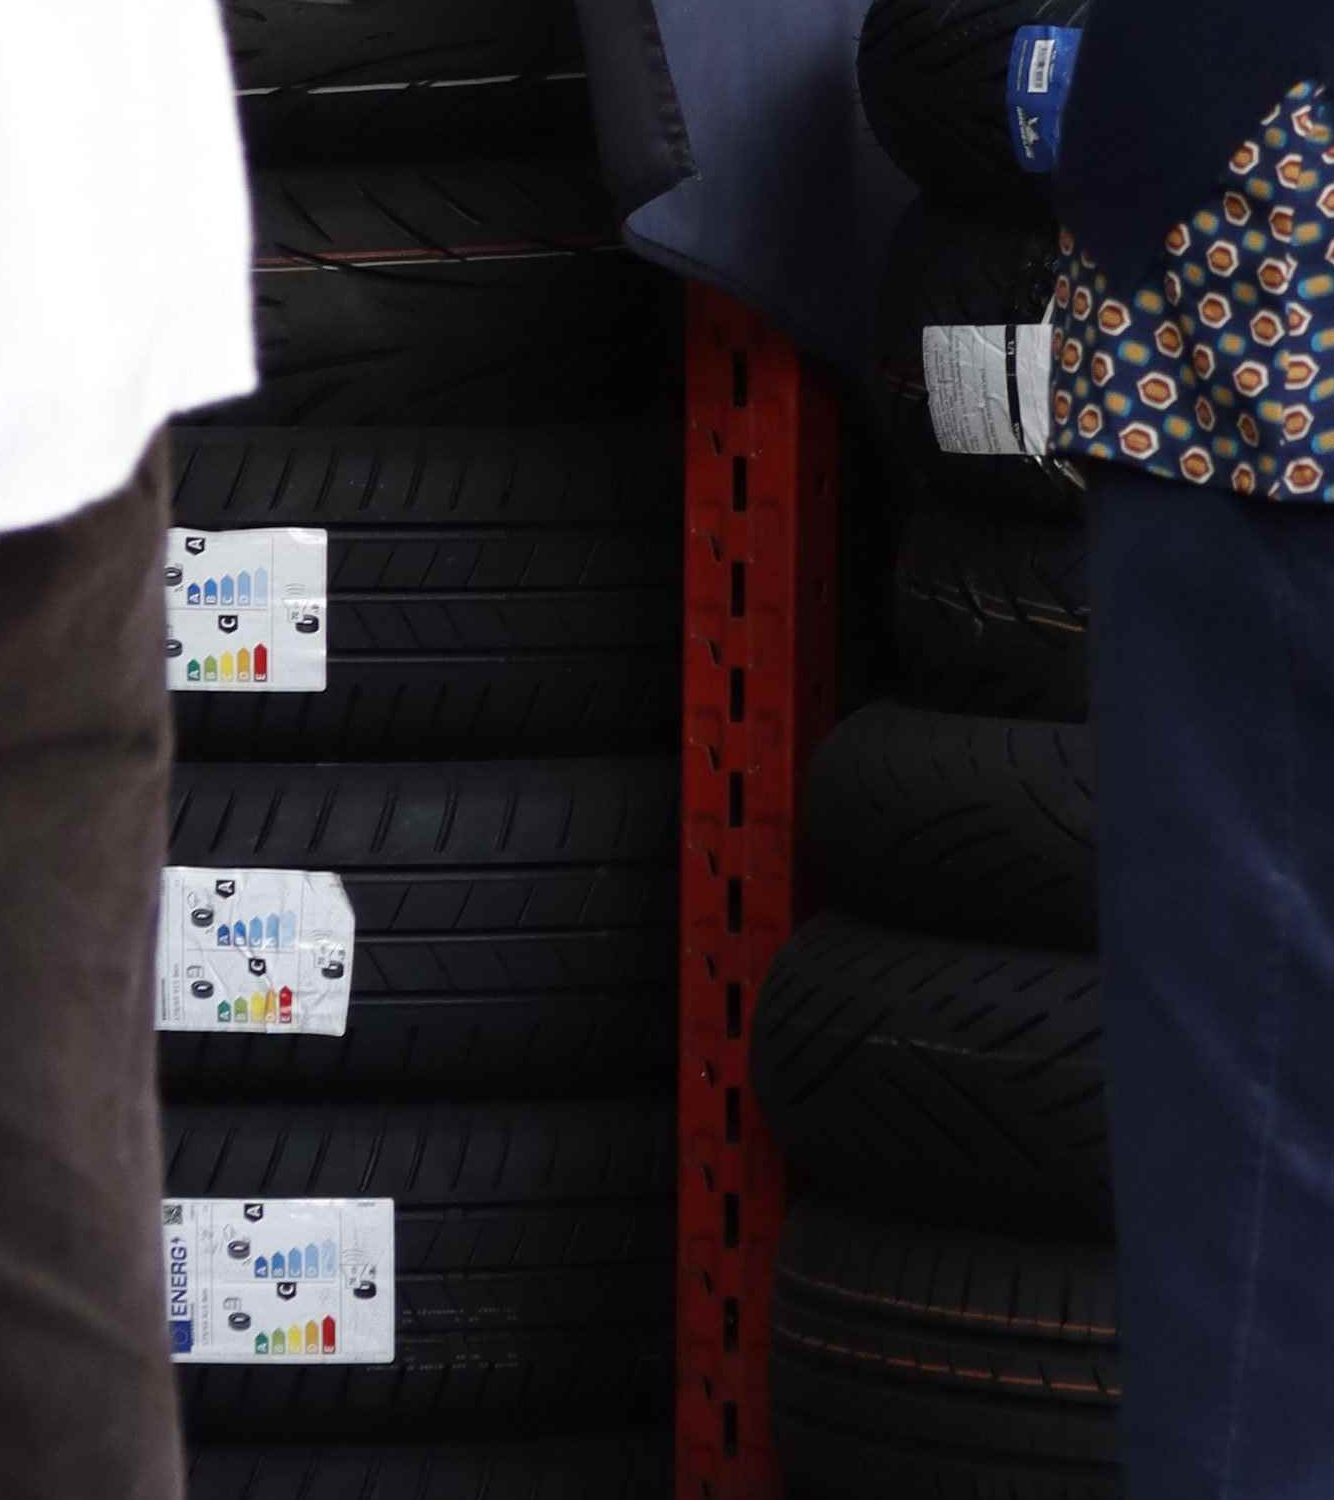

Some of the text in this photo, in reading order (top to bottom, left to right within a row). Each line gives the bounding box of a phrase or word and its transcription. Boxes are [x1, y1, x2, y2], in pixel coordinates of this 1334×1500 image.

[187, 538, 204, 550] A
[220, 617, 236, 628] C
[246, 1204, 263, 1218] A
[279, 1284, 295, 1295] C
